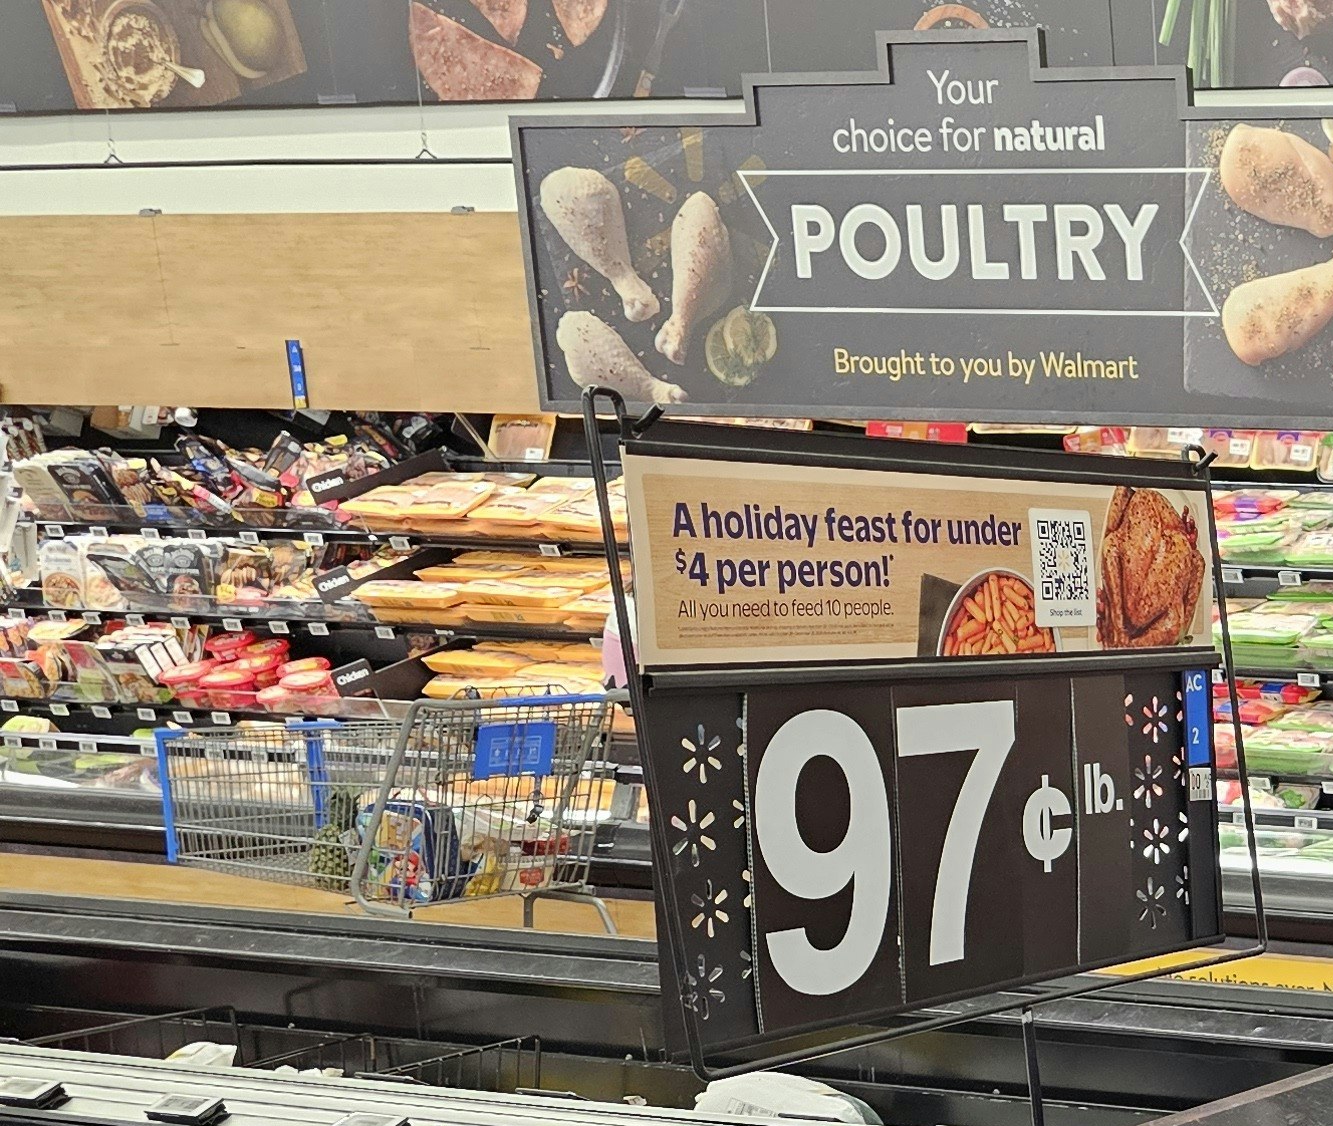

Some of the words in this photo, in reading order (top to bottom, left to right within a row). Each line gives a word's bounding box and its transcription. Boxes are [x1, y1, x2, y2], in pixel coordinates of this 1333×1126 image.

[926, 69, 999, 107] Your
[832, 119, 932, 154] choice
[937, 117, 986, 152] for
[993, 115, 1106, 152] natural
[790, 203, 1160, 282] POULTRY
[833, 348, 925, 382] Brought
[930, 354, 953, 378] to
[958, 357, 1003, 384] you
[1007, 350, 1036, 386] by
[1039, 351, 1140, 382] Walmart
[673, 502, 697, 538] A
[701, 502, 819, 548] holiday
[823, 507, 898, 543] feast
[902, 510, 945, 545] for
[948, 514, 1022, 546] under
[675, 548, 710, 587] $4
[716, 556, 771, 594] per
[677, 600, 697, 619] All
[699, 603, 730, 621] you
[732, 600, 771, 618] need
[773, 601, 788, 617] to
[791, 599, 824, 617] feed
[826, 599, 841, 616] 10
[844, 600, 895, 619] people.
[1185, 673, 1203, 693] AC
[1192, 727, 1200, 745] 2
[1083, 762, 1124, 817] lb.
